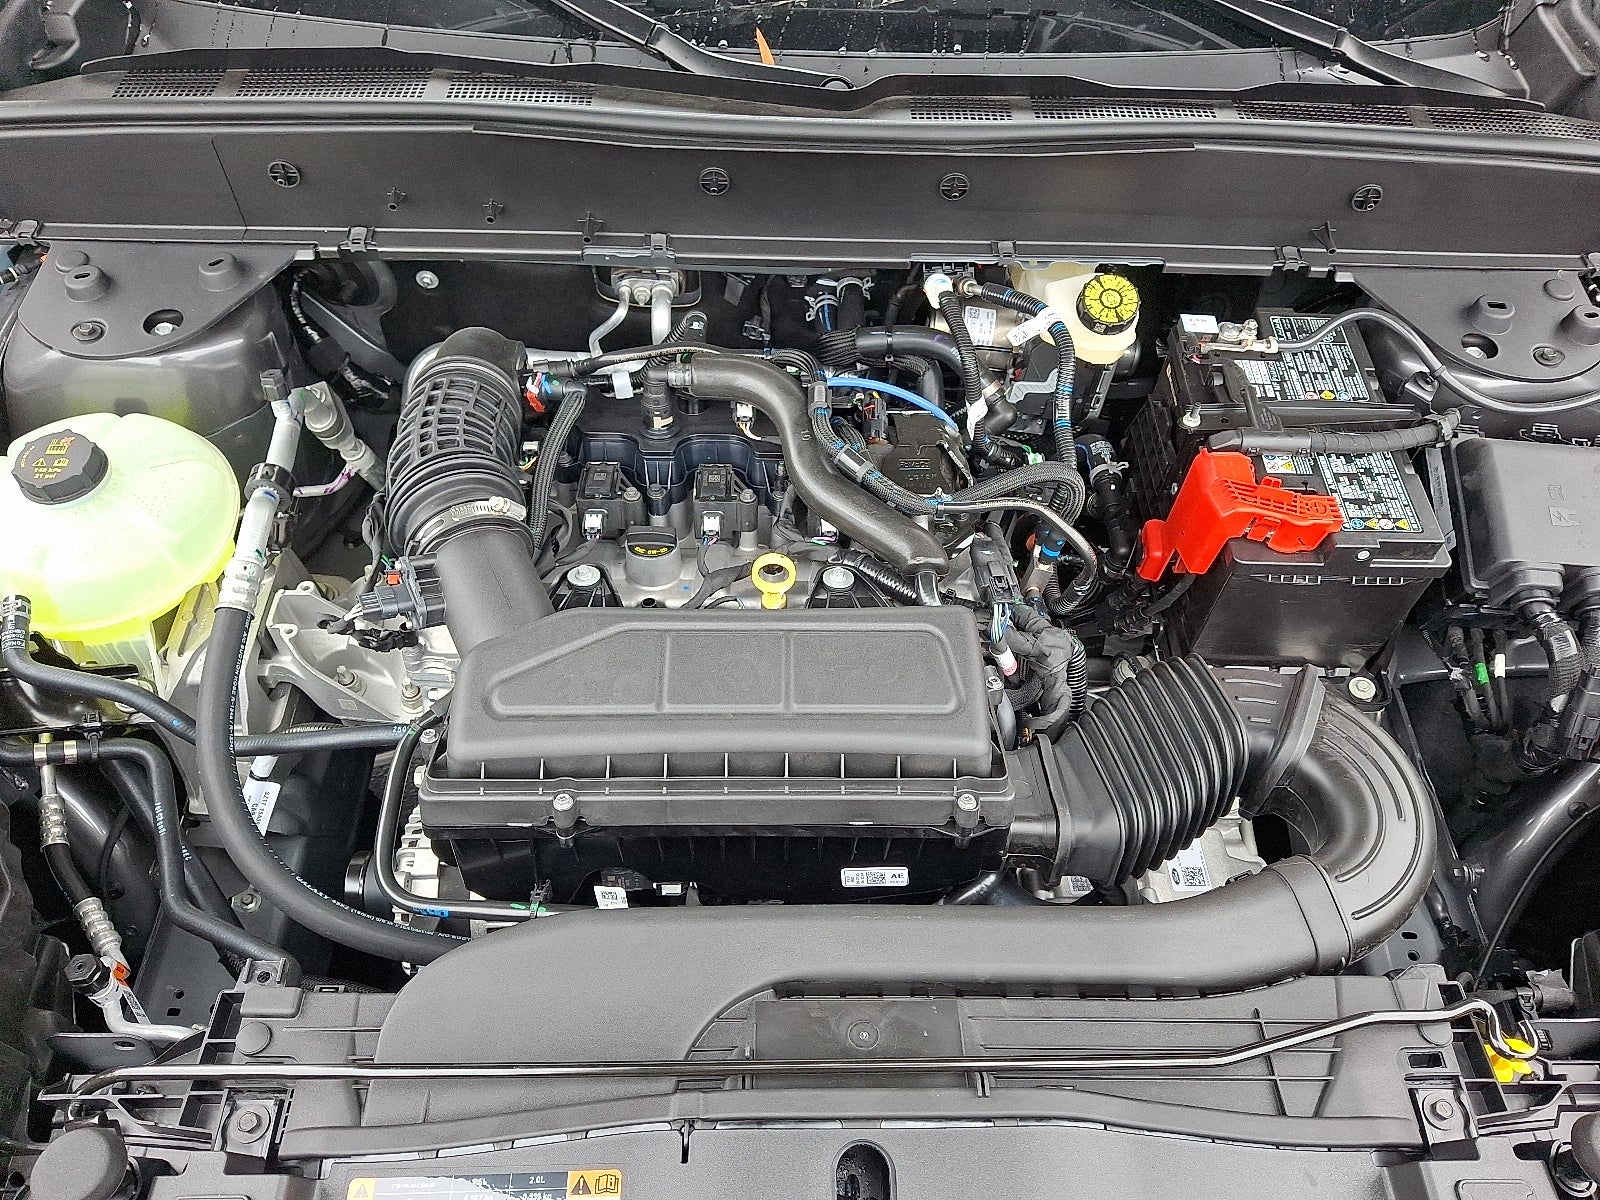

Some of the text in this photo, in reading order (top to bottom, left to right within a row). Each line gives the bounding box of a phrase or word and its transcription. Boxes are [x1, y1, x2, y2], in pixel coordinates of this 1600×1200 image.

[234, 644, 245, 675] SUCTION
[231, 675, 239, 695] HOSE
[528, 1175, 546, 1184] 2.0L
